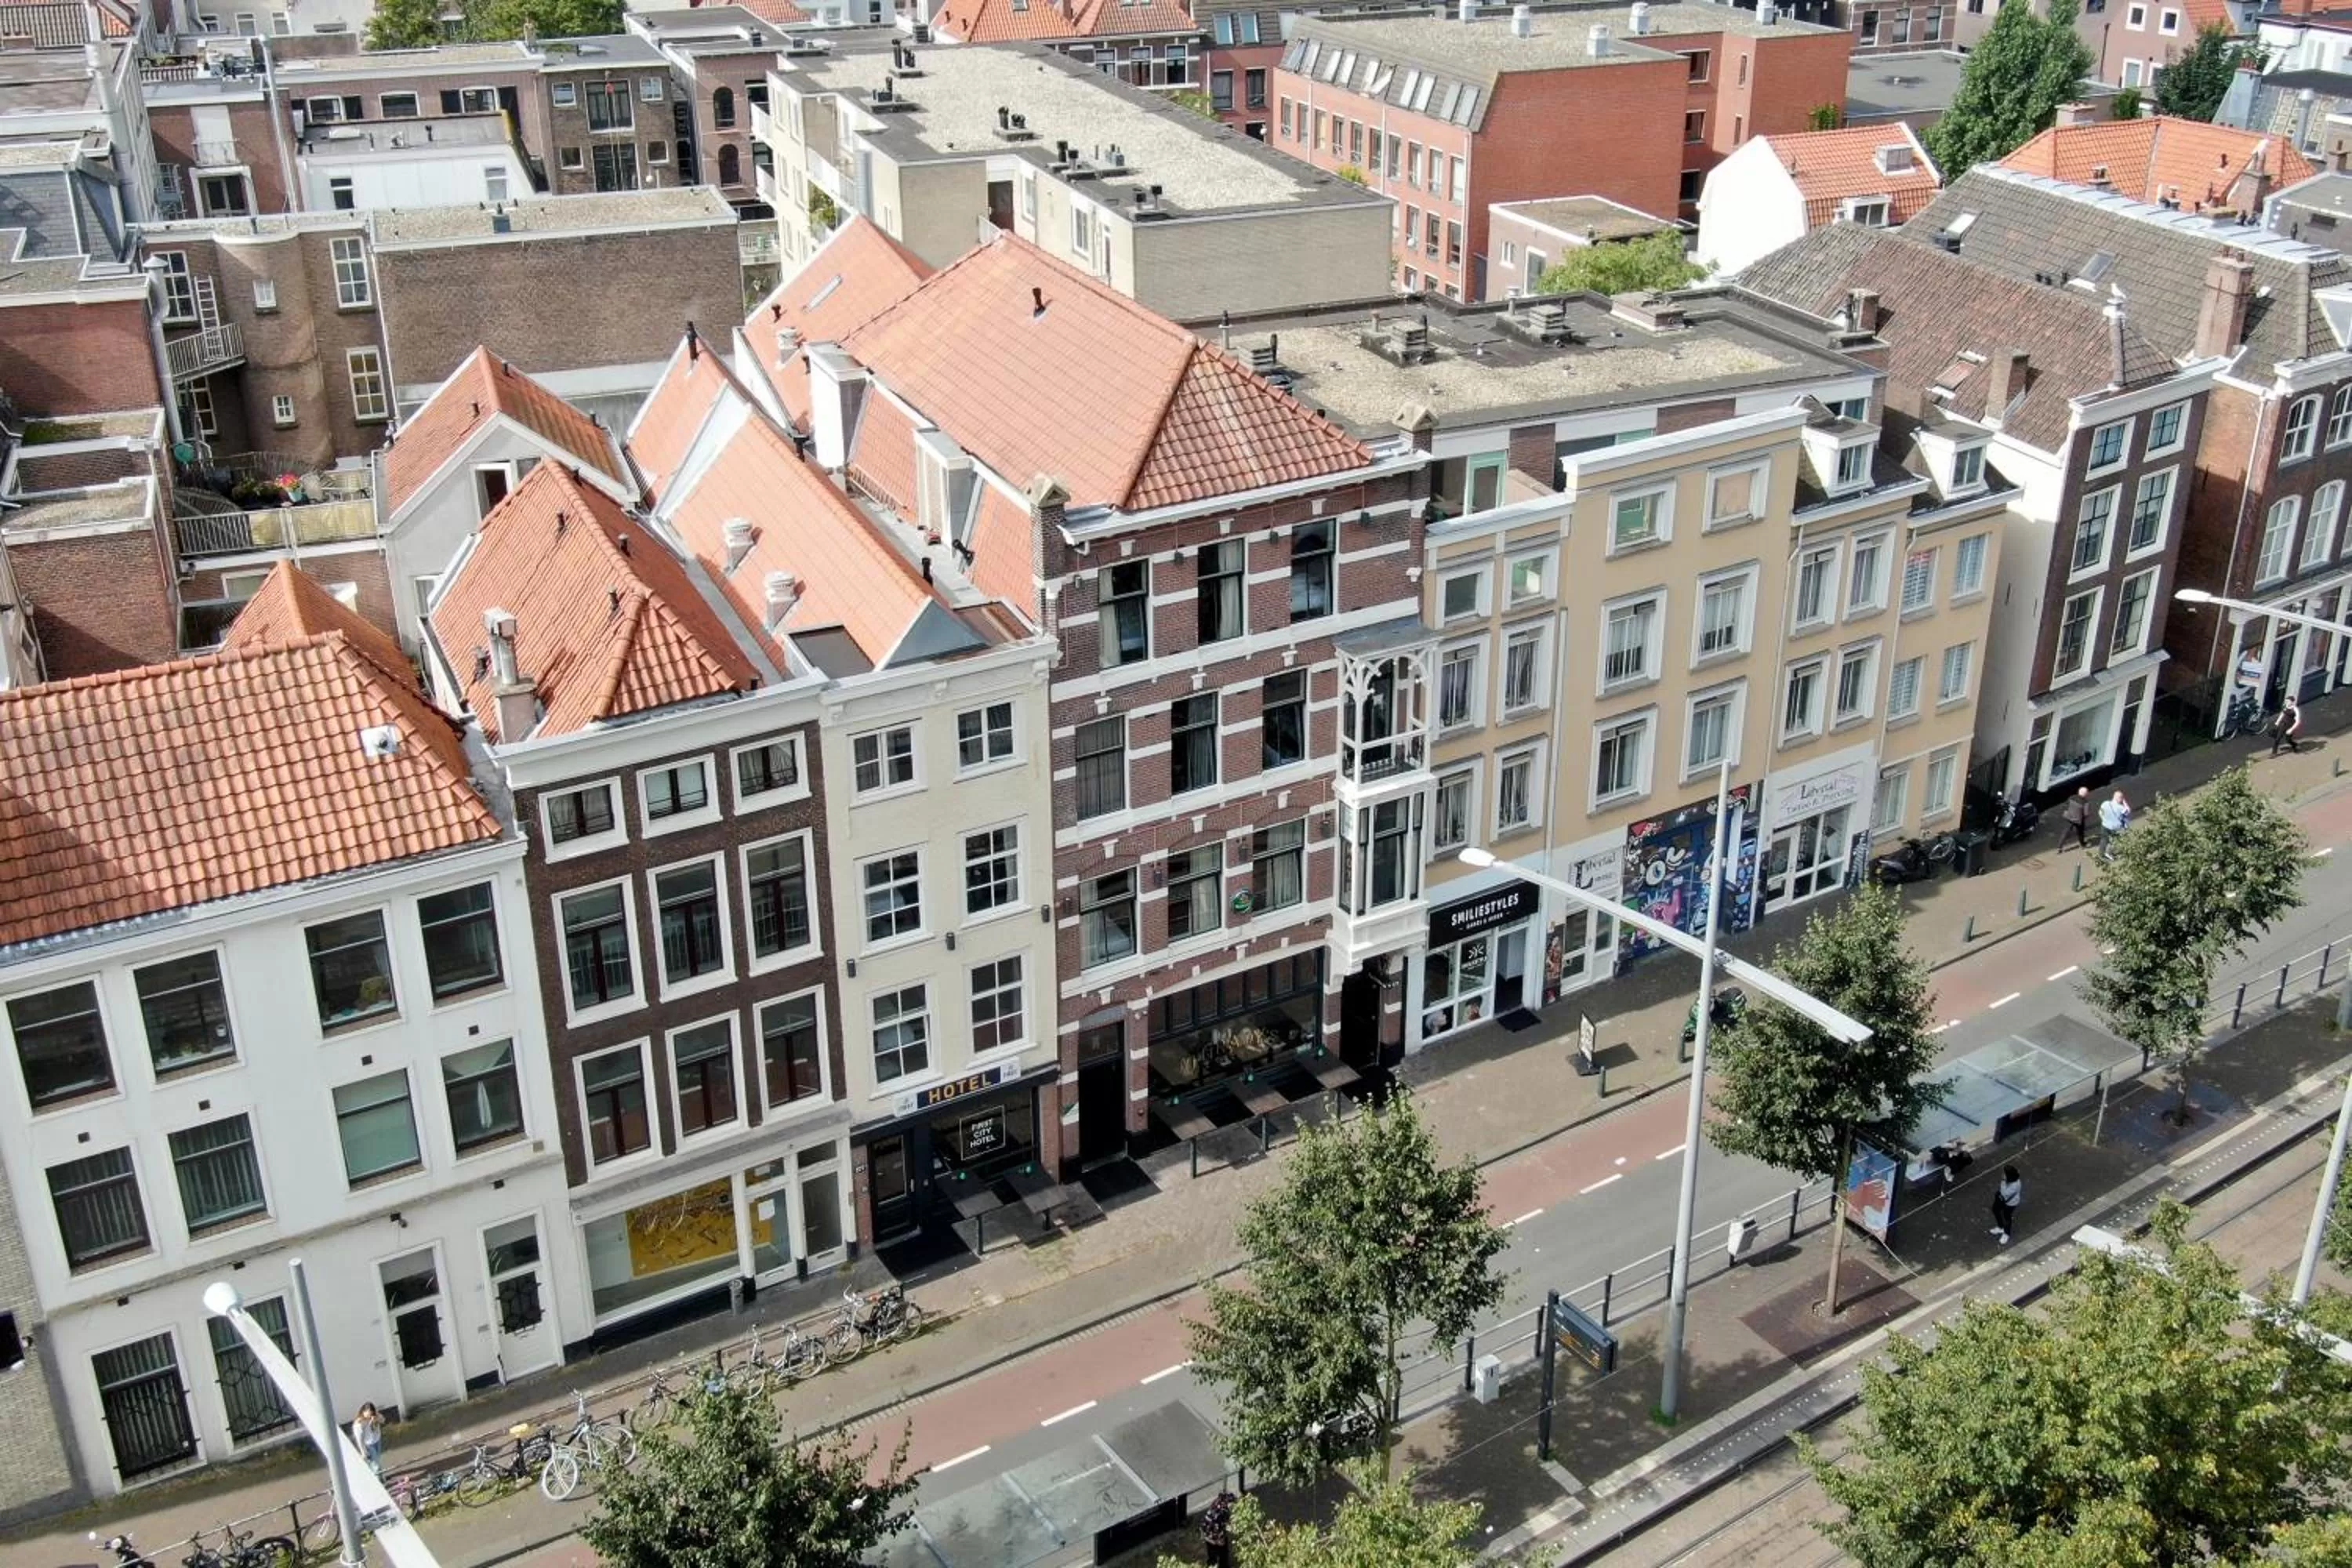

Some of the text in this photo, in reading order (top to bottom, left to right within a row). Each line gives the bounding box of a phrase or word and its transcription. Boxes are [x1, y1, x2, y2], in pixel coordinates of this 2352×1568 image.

[1451, 893, 1519, 926] SMILIESTYLES
[928, 1073, 992, 1104] HOTEL
[971, 1118, 993, 1131] FIRST
[973, 1127, 992, 1138] CITY
[970, 1134, 996, 1148] HOTEL
